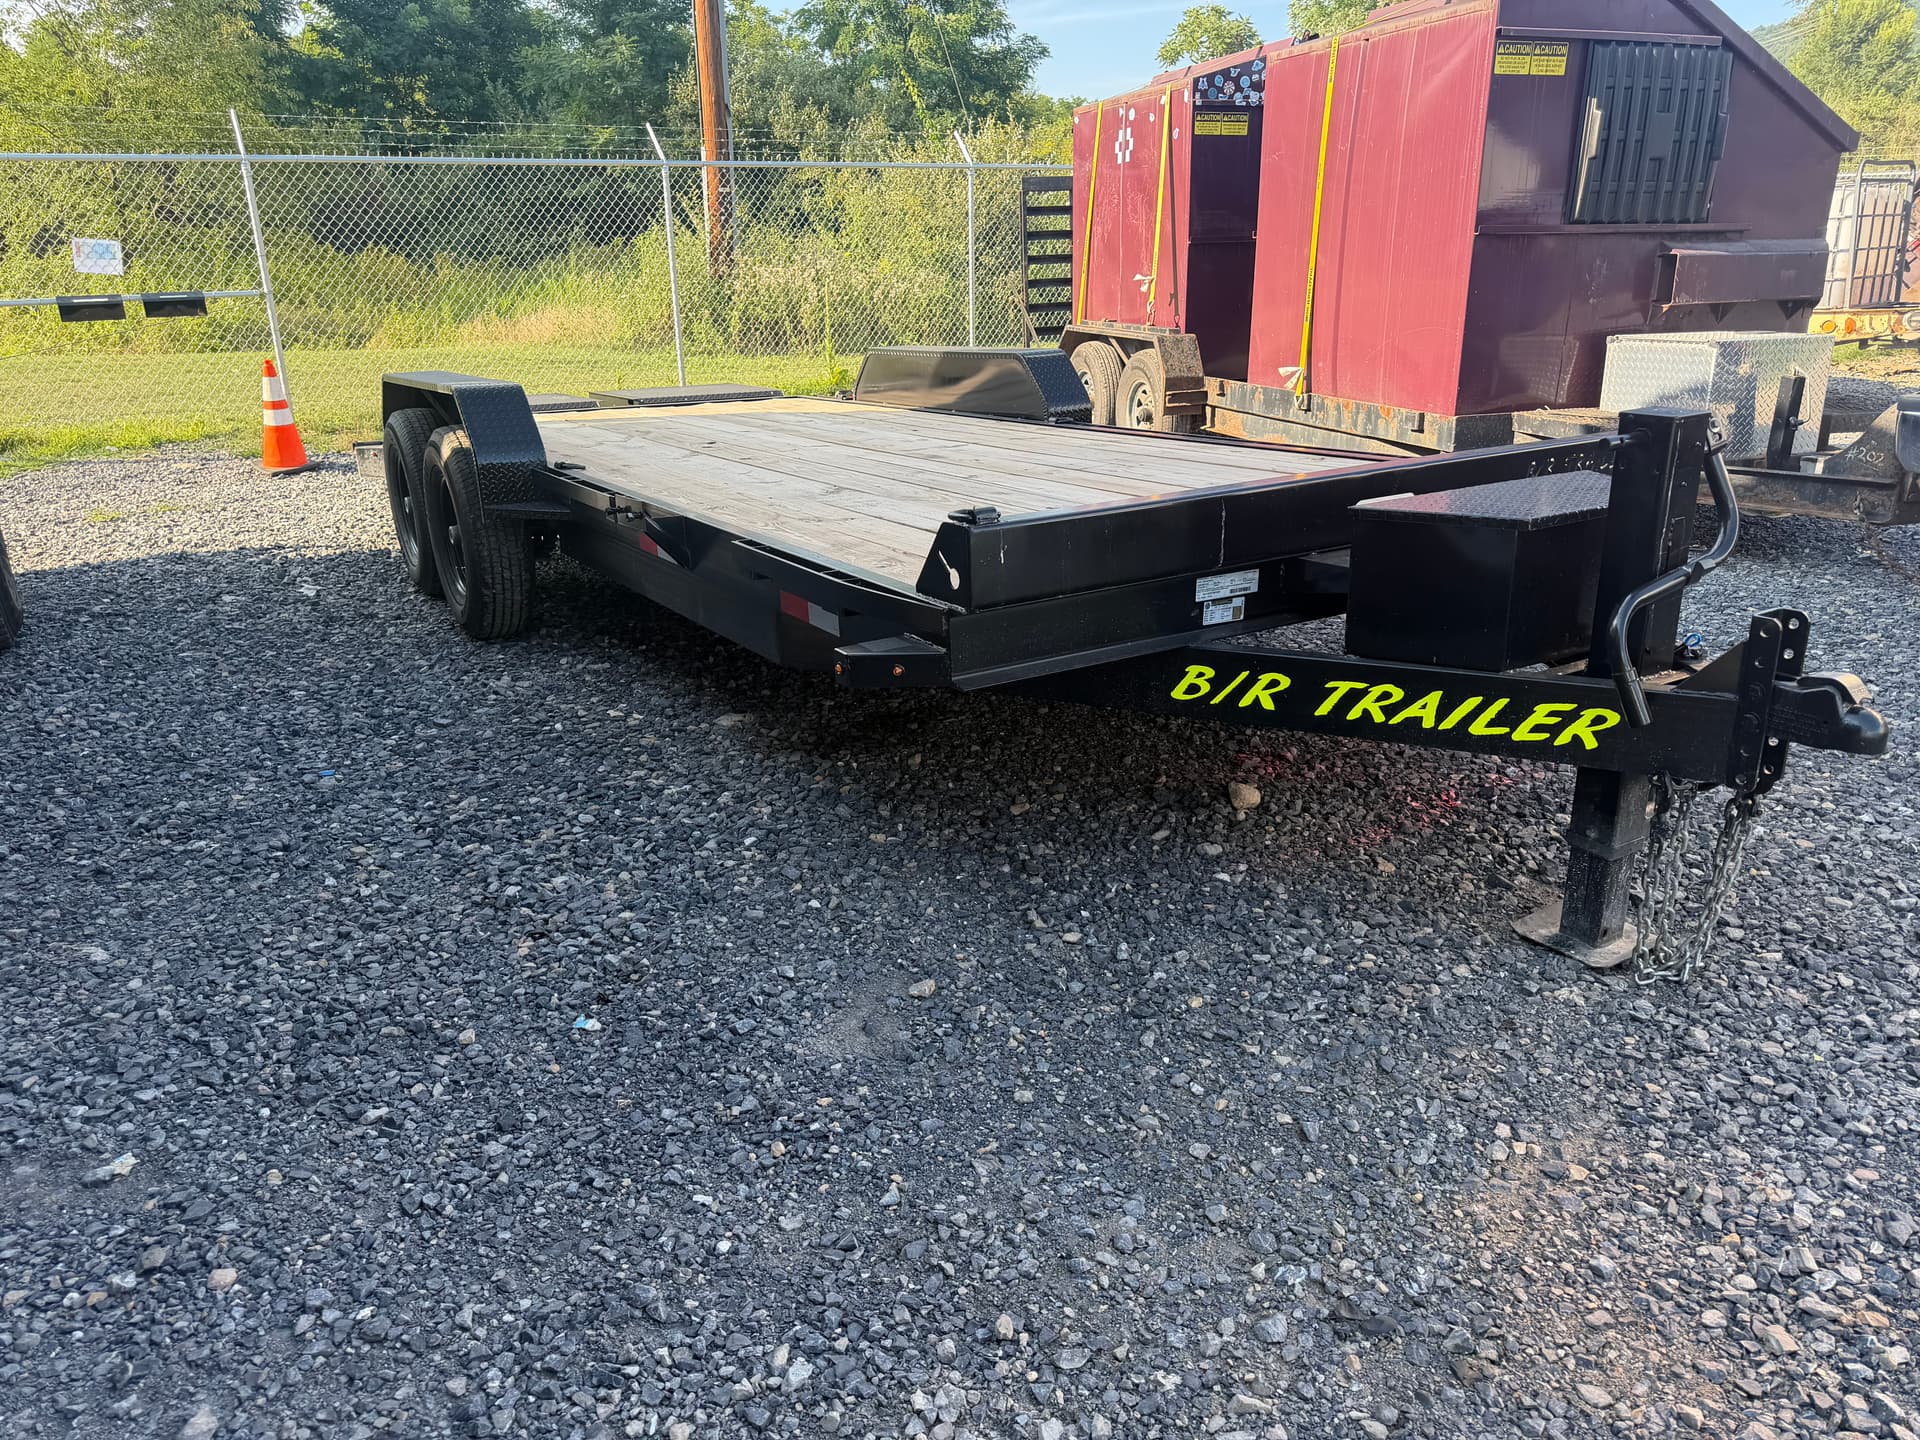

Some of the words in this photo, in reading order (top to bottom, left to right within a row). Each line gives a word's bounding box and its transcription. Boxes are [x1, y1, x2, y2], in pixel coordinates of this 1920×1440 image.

[1504, 44, 1531, 54] CAUTION
[1540, 45, 1567, 55] CAUTION
[1170, 664, 1292, 711] B/R
[1314, 680, 1622, 751] TRAILER
